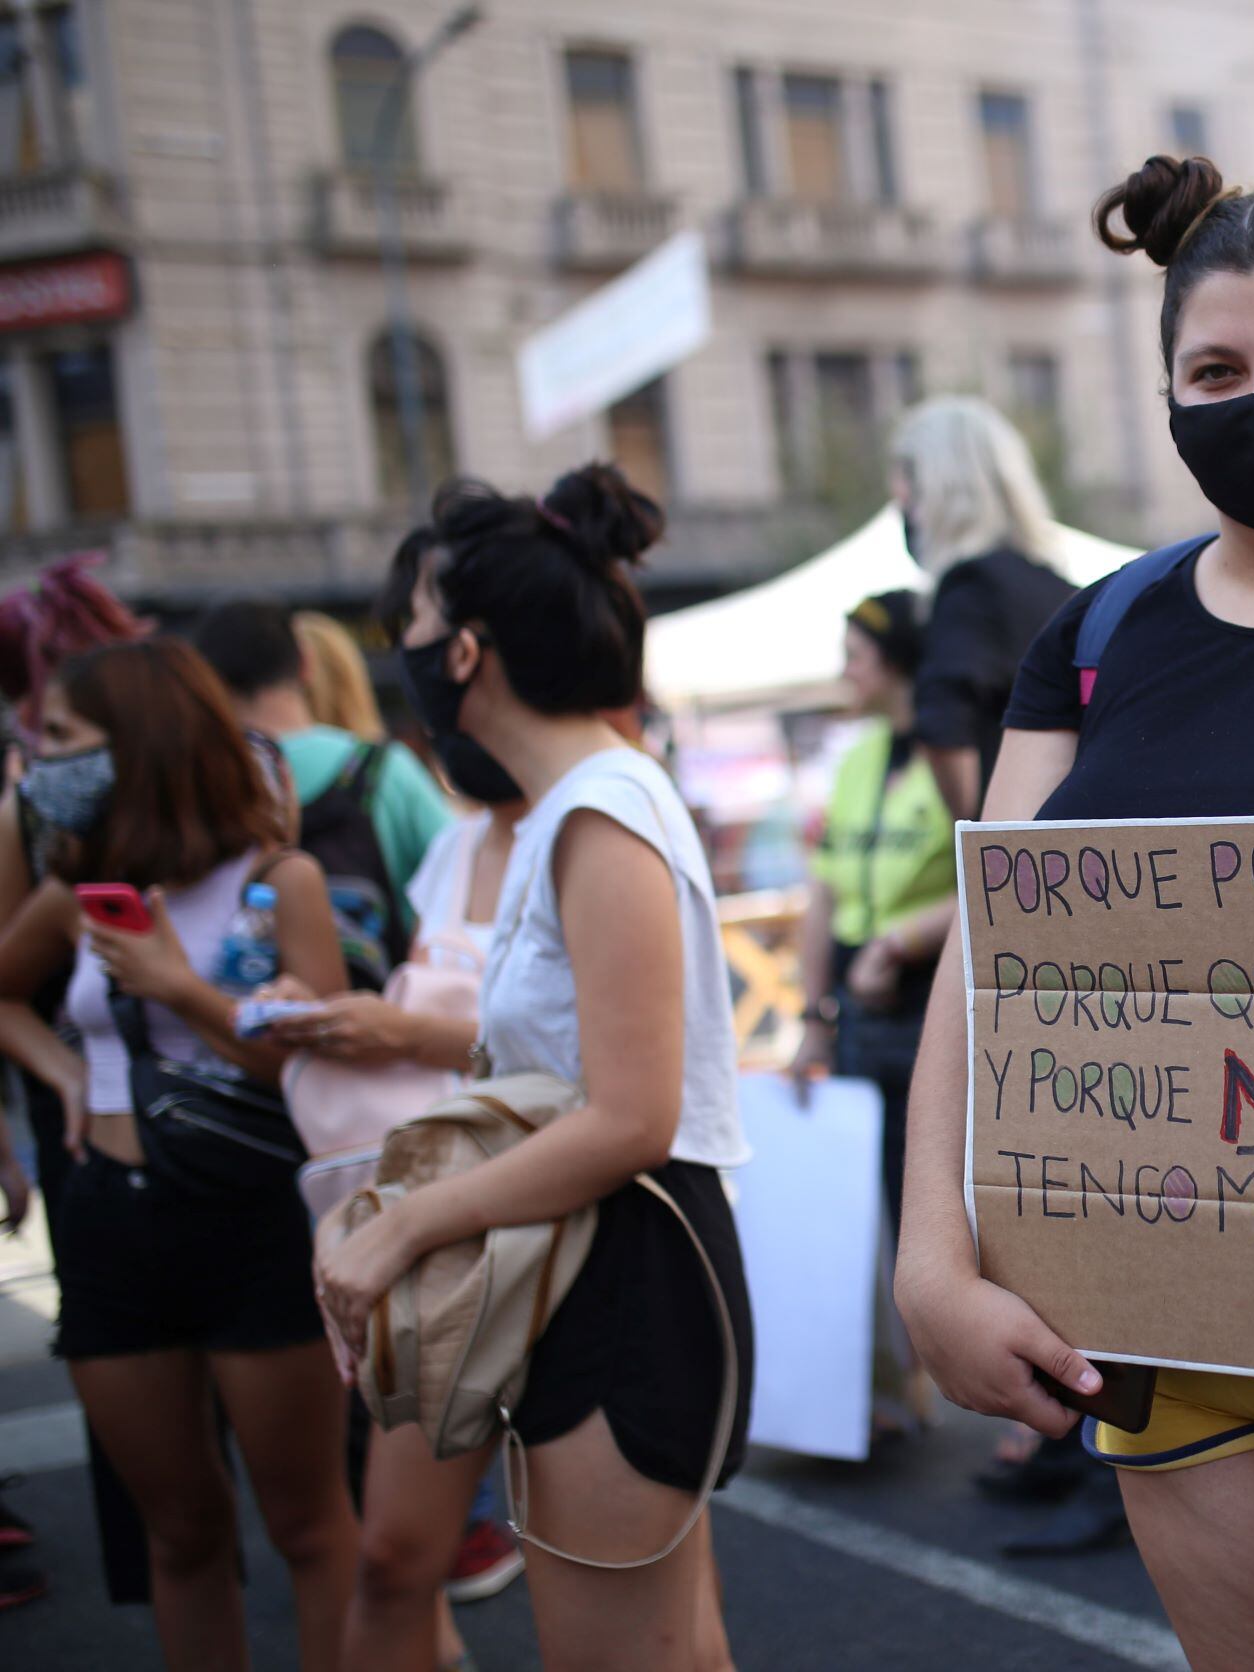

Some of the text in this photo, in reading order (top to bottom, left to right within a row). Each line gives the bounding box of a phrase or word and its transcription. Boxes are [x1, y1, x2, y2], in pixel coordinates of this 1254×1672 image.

[980, 845, 1182, 925] PORQUE
[994, 952, 1191, 1033] PORQUE
[985, 1049, 1012, 1119] Y
[1030, 1048, 1192, 1130] PORQUE
[998, 1151, 1197, 1224] TENGO
